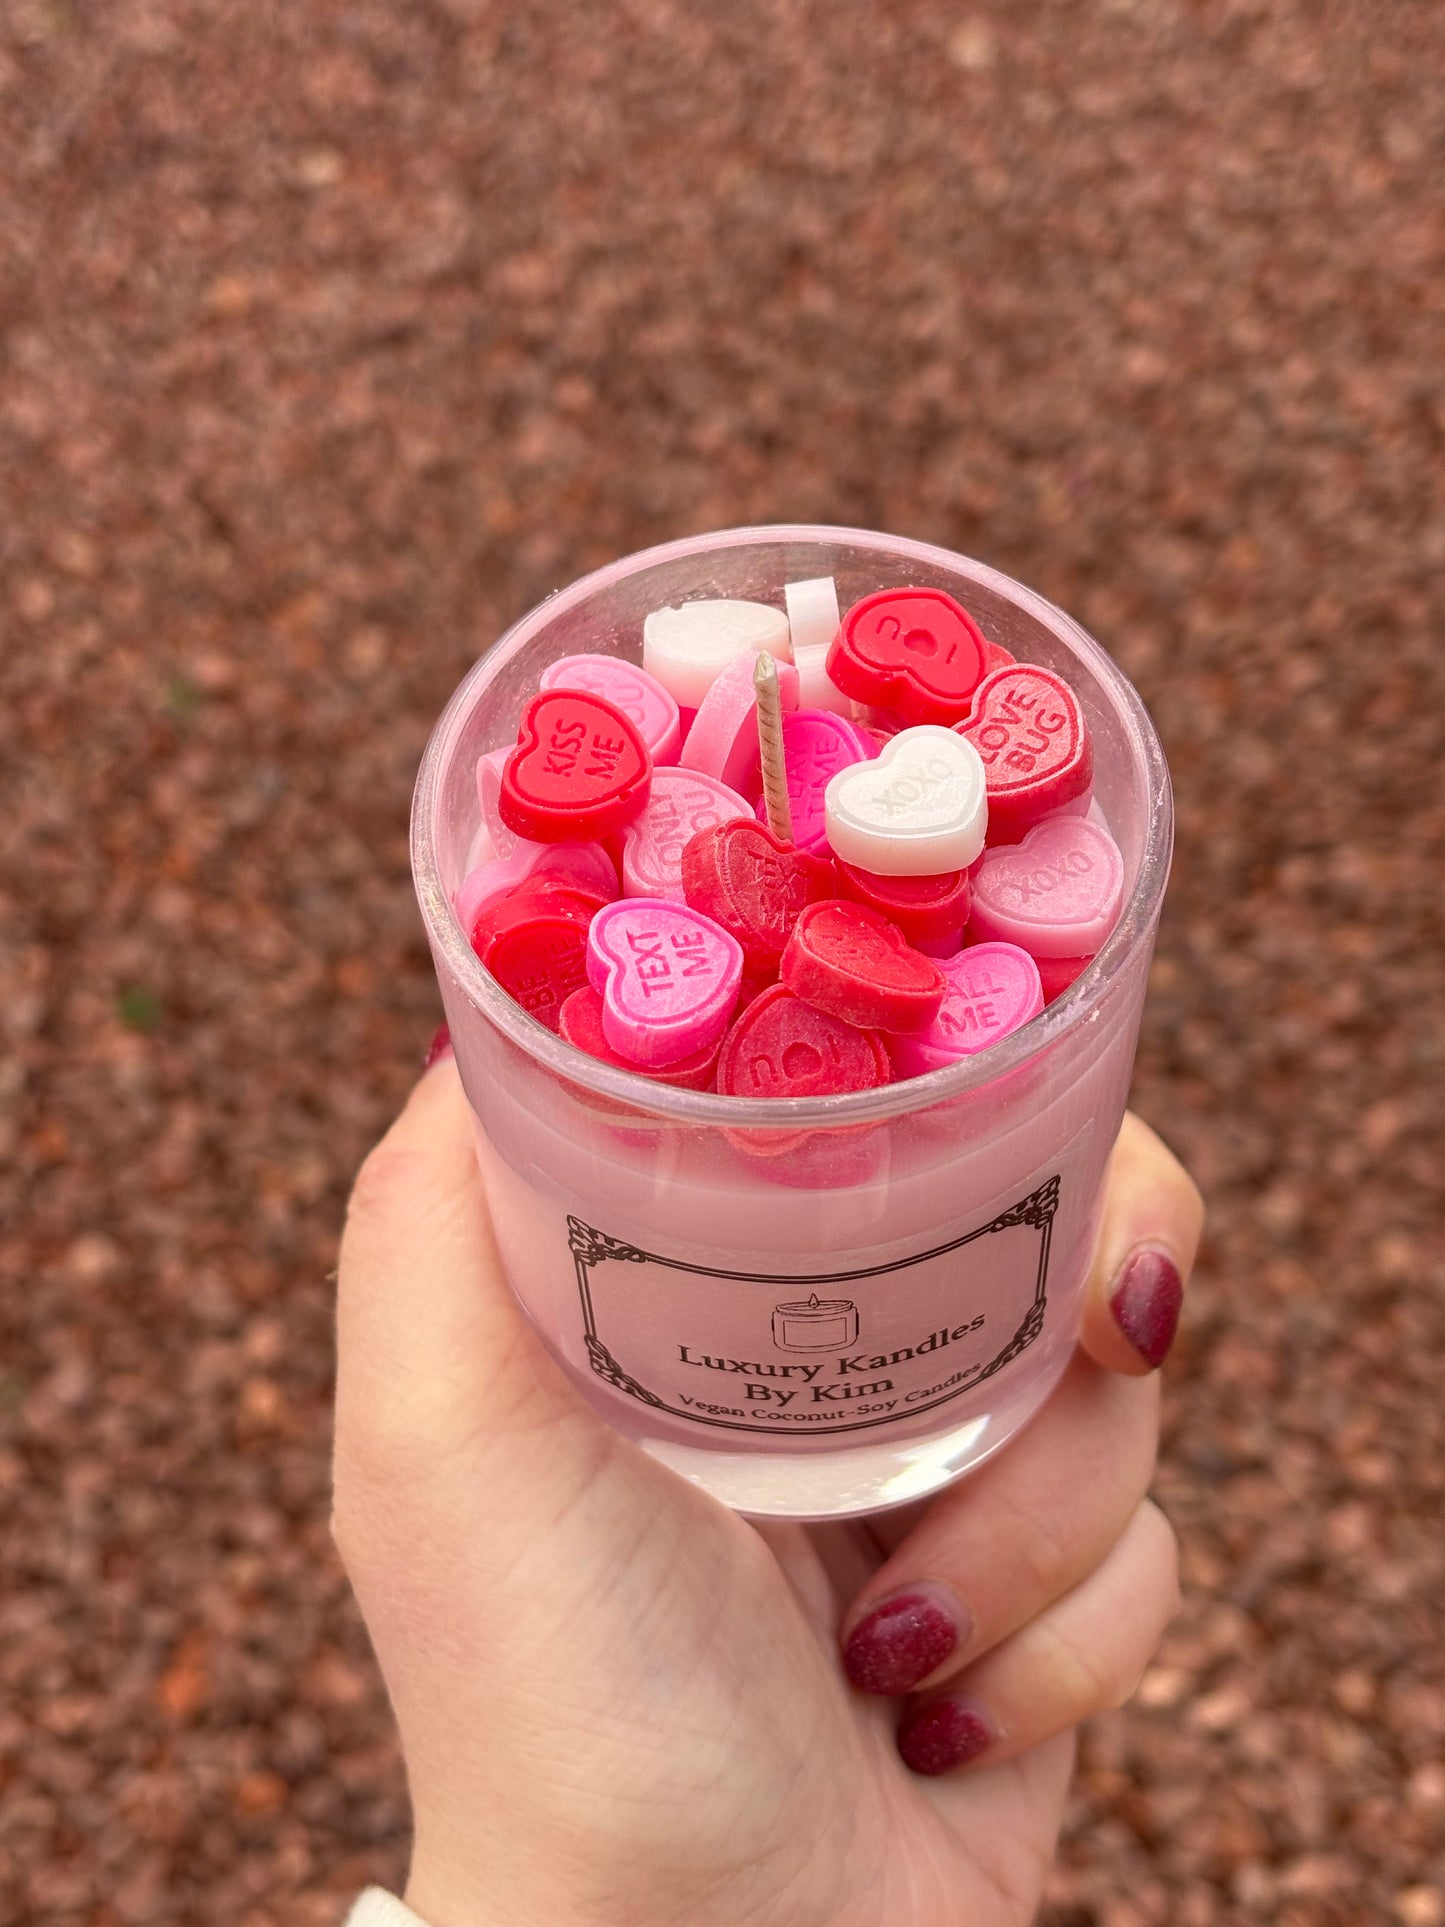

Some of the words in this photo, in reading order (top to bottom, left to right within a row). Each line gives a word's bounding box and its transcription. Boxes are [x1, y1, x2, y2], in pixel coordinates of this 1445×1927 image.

[542, 718, 588, 778] KISS
[979, 690, 1038, 765] LOVE
[1003, 709, 1067, 772] BUG
[584, 735, 625, 781] ME
[683, 790, 722, 834] OU
[871, 758, 953, 816] XOXO
[1003, 849, 1095, 904] XOXO
[626, 928, 675, 998] TEXT
[670, 930, 713, 977] ME
[946, 970, 1006, 1000] ALL
[938, 1000, 1001, 1035] ME
[676, 1343, 825, 1383] Luxury
[836, 1313, 987, 1375] Kandles
[677, 1393, 746, 1418] Vegan
[751, 1397, 899, 1422] Coconut-Soy
[904, 1362, 982, 1404] Candles
[743, 1382, 798, 1407] By
[811, 1378, 896, 1403] Kim
